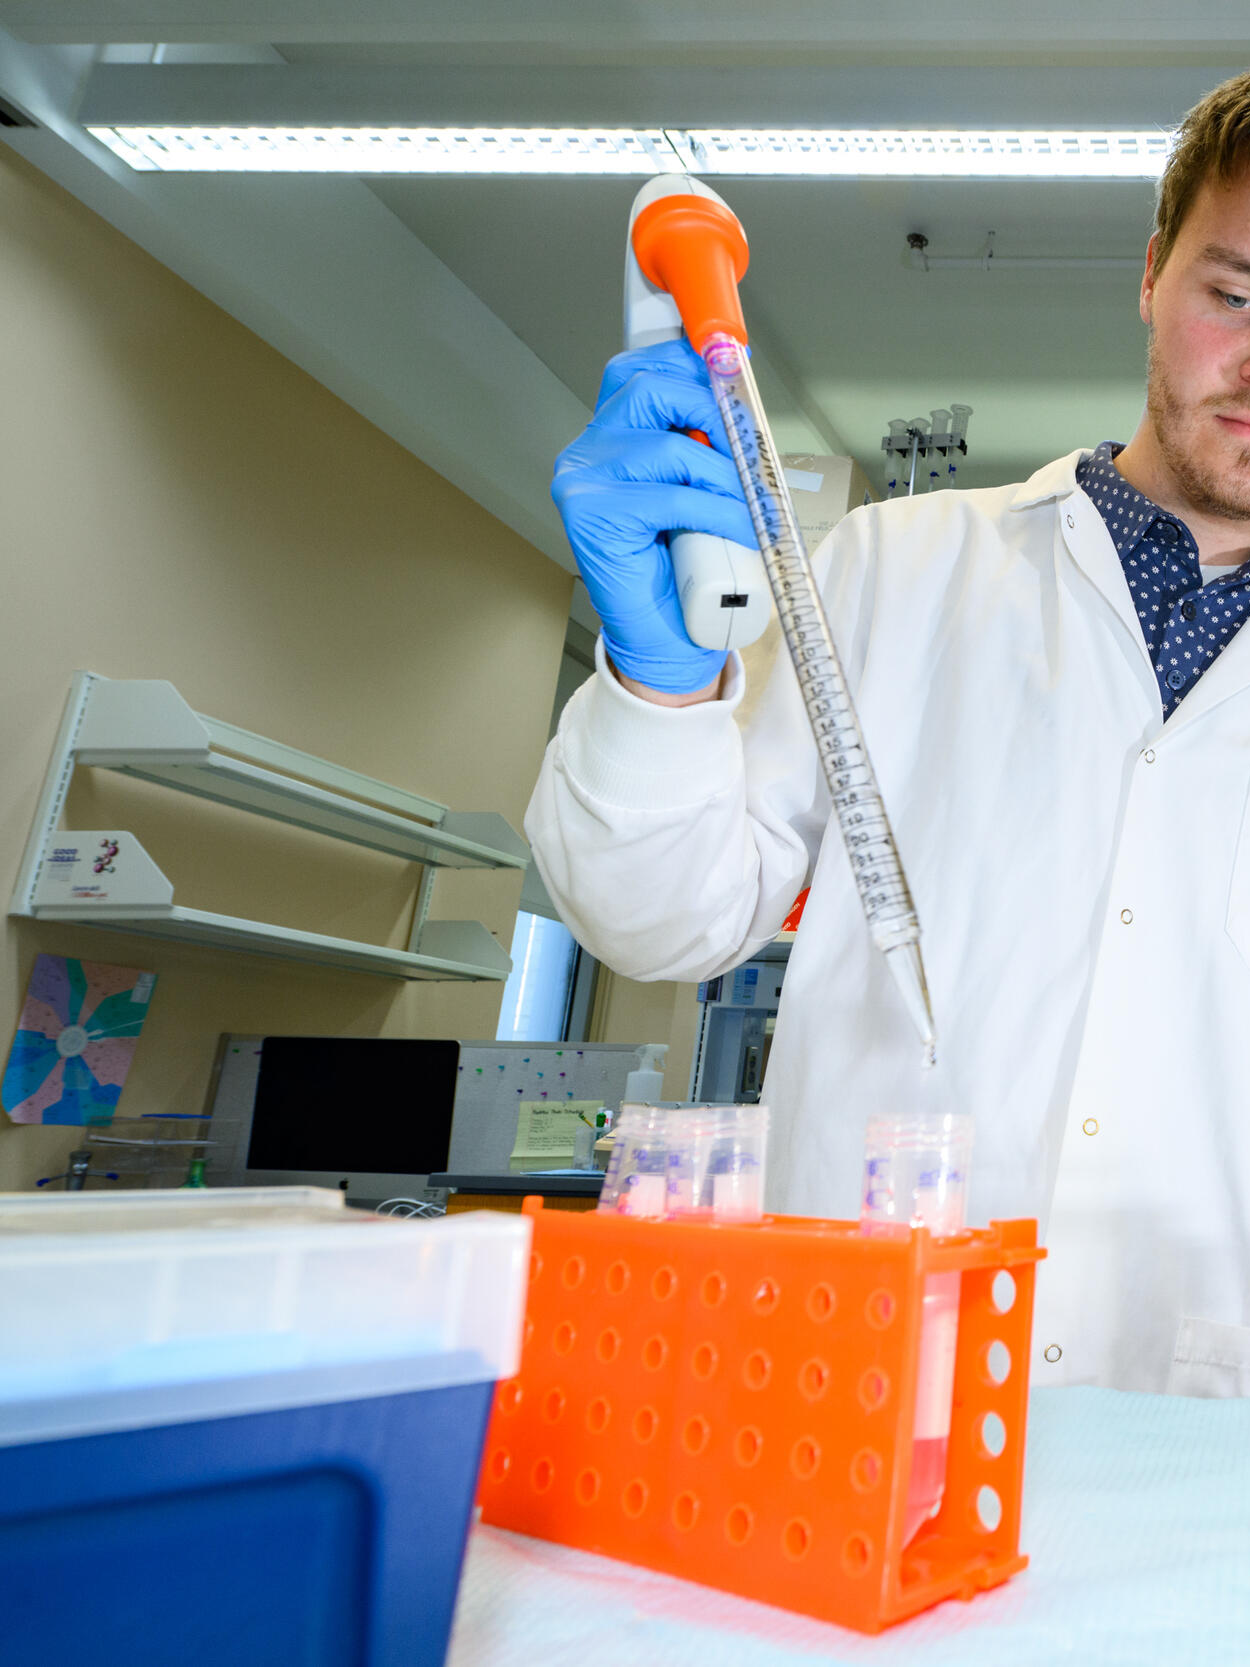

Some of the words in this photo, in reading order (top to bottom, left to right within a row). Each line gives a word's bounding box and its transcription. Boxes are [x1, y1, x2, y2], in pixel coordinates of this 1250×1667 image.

[825, 736, 842, 750] 15
[831, 755, 848, 769] 16
[836, 773, 851, 788] 17
[848, 812, 864, 826] 19
[850, 832, 870, 847] 20
